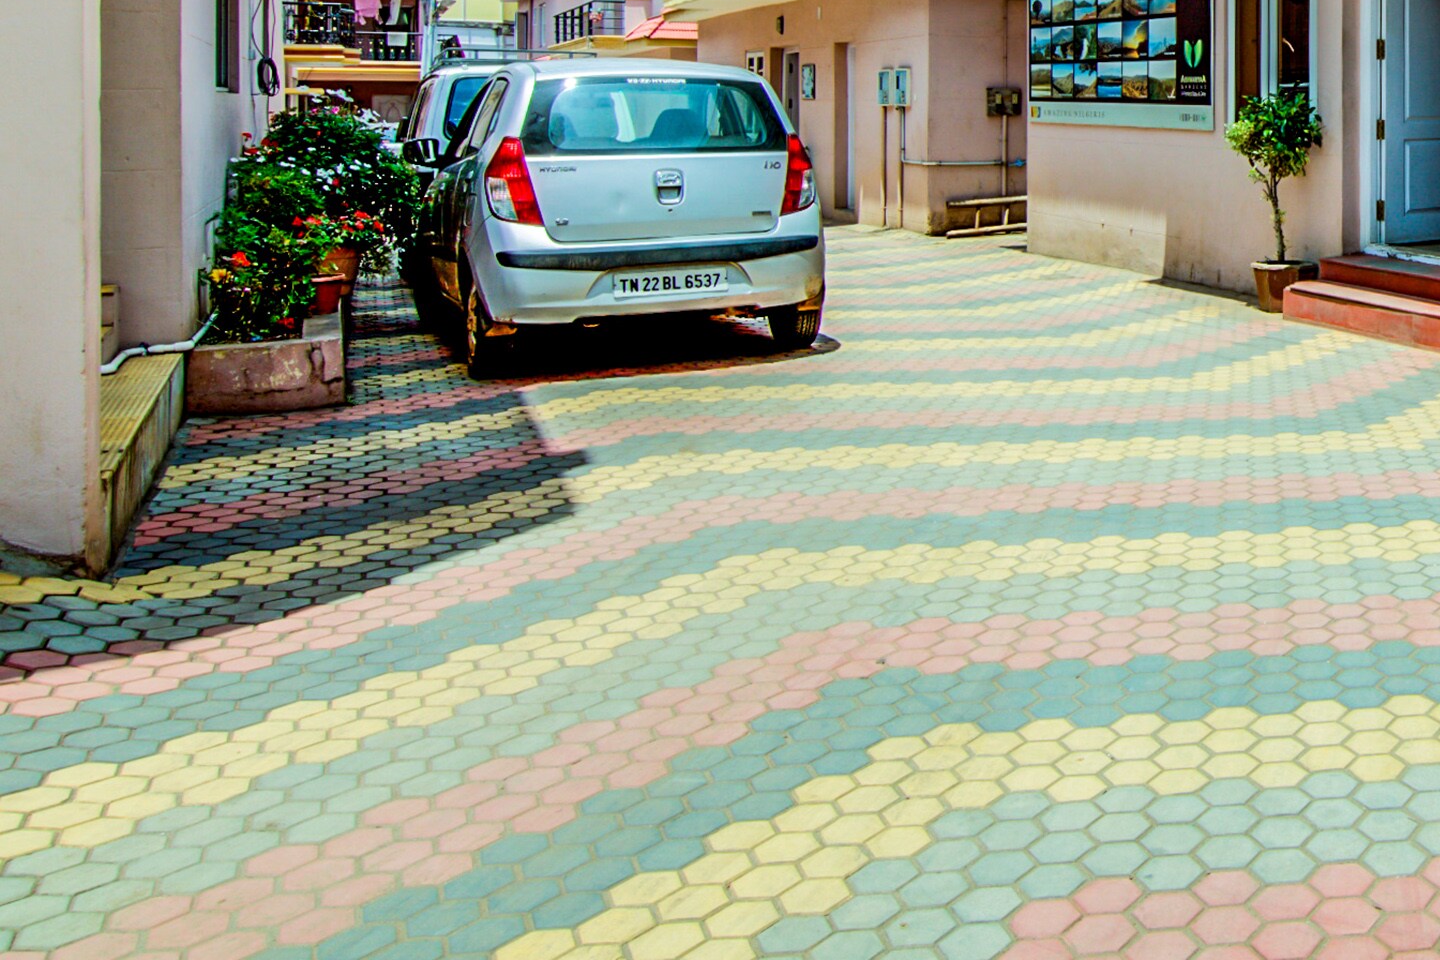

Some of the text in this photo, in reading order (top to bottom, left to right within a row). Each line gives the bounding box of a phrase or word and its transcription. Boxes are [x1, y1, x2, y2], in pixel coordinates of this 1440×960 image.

[619, 273, 721, 293] TN 22 BL 6537
